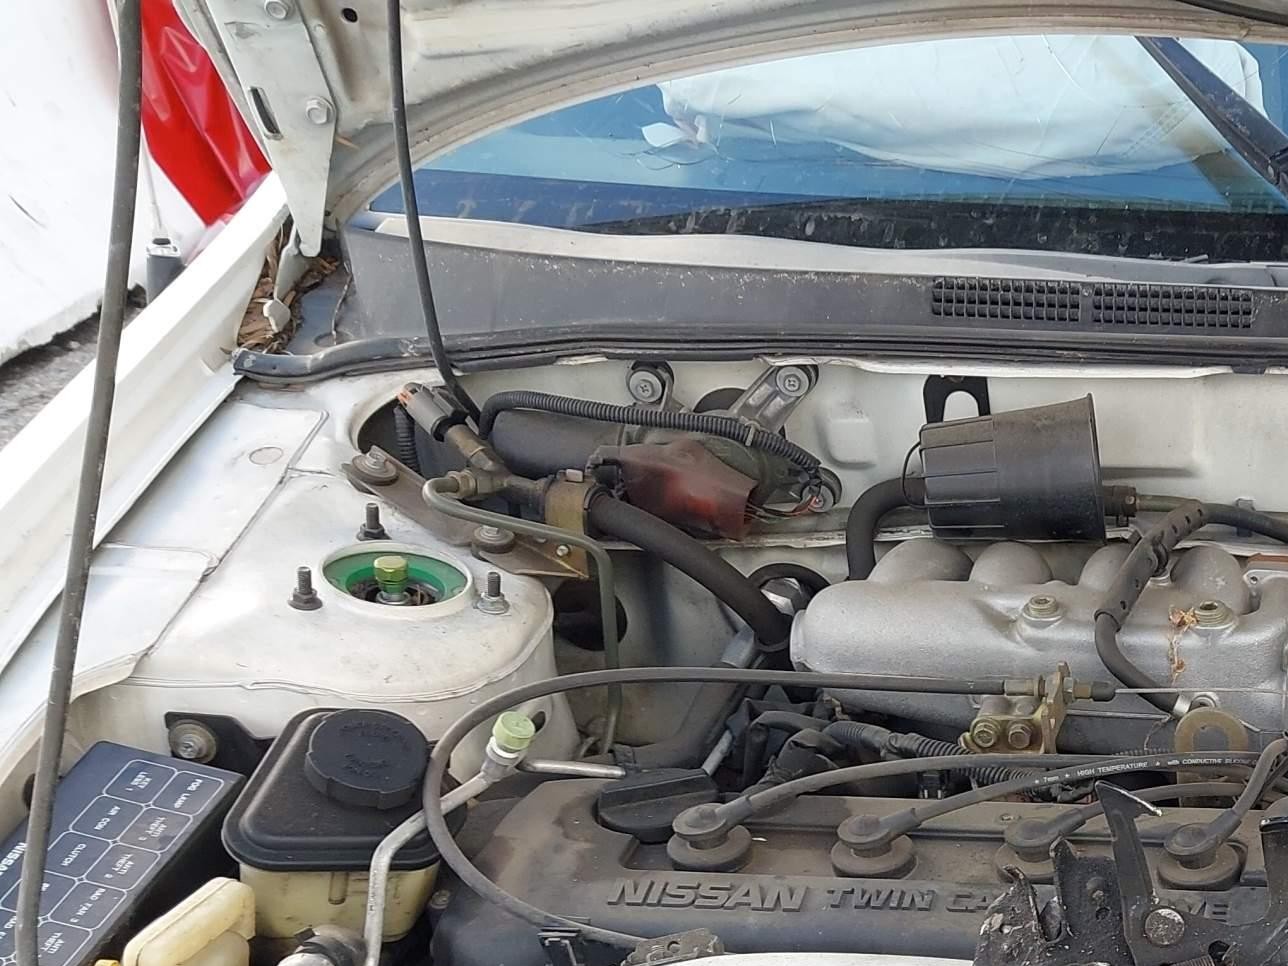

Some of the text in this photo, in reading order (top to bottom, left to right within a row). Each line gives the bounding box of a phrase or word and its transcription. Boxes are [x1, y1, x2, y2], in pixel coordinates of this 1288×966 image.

[1077, 761, 1148, 777] HIGH TEMPERATURE
[60, 843, 87, 867] CLUTCH
[111, 853, 133, 871] THEFT
[117, 861, 134, 875] ANTI
[607, 876, 809, 913] NISSAN
[825, 887, 938, 912] TWIN
